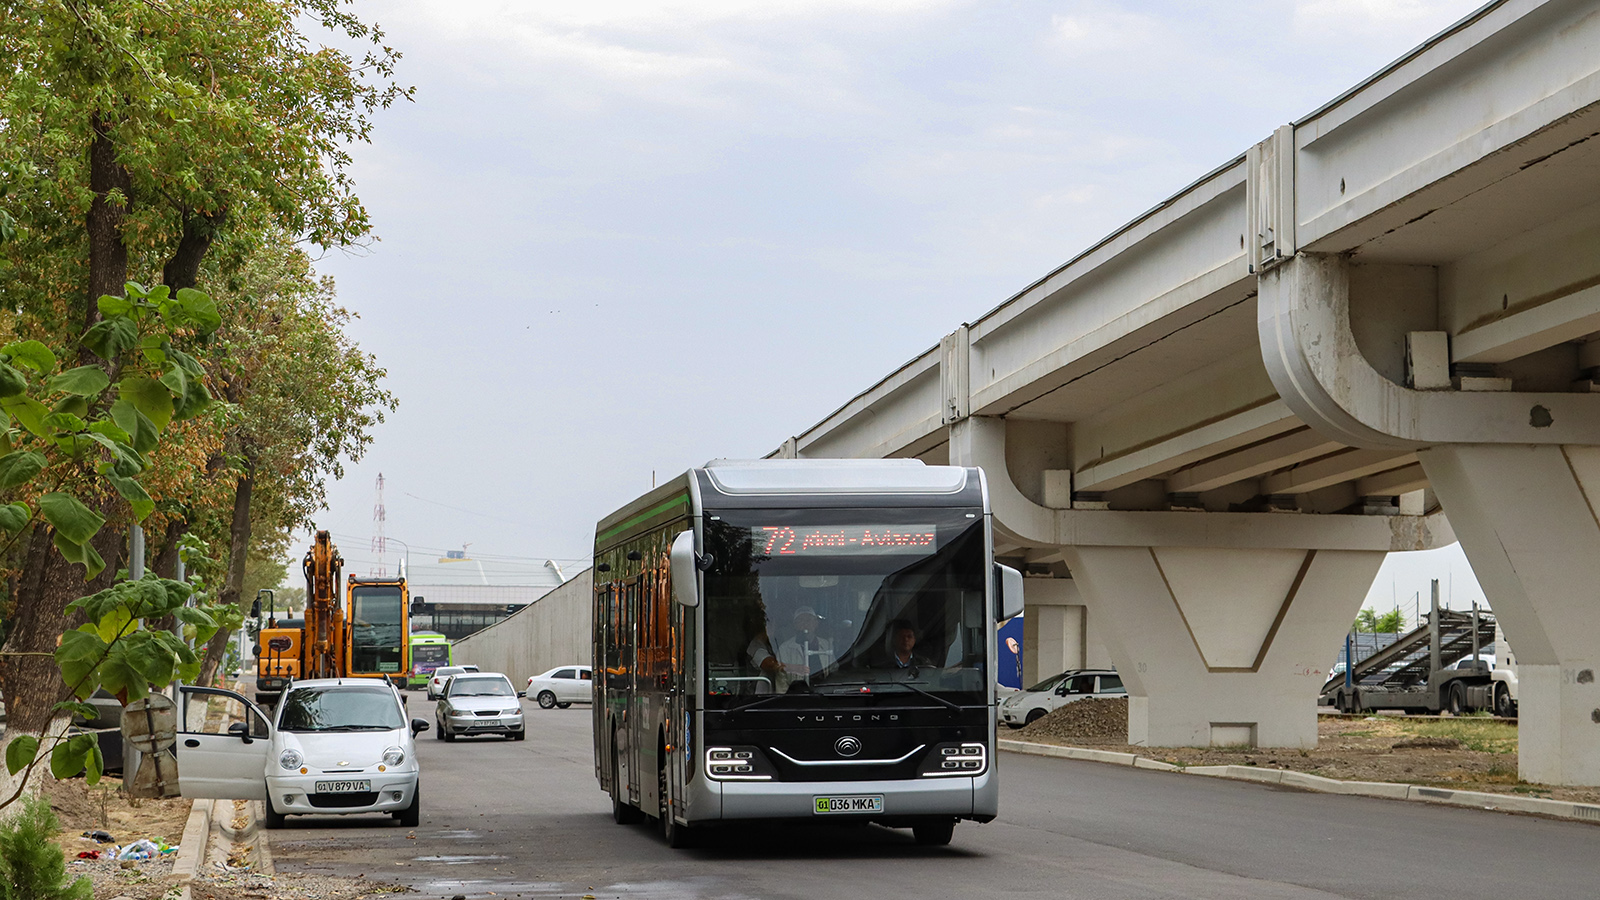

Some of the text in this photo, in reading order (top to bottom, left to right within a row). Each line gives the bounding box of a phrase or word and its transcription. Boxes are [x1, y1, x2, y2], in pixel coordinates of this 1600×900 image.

[763, 526, 796, 554] 72
[317, 783, 326, 791] 01
[818, 800, 828, 809] 01
